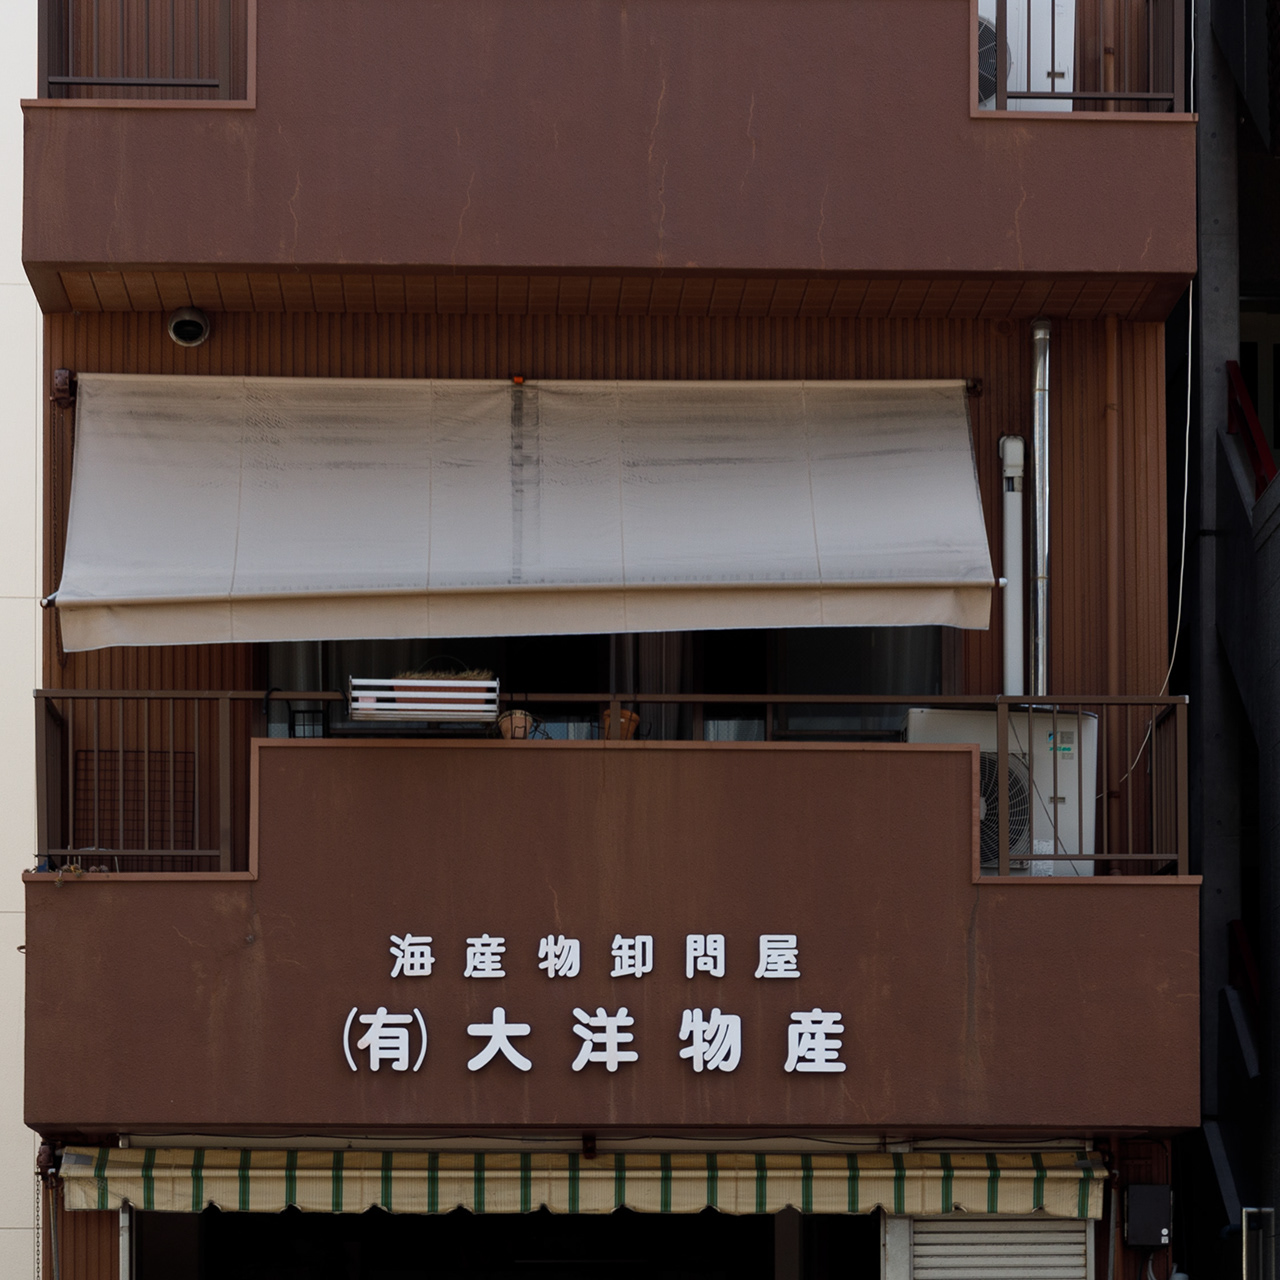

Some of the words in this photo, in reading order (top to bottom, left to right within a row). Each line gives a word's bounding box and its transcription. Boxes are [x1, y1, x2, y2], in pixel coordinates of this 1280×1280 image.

[390, 933, 801, 979] 海産物卸問屋
